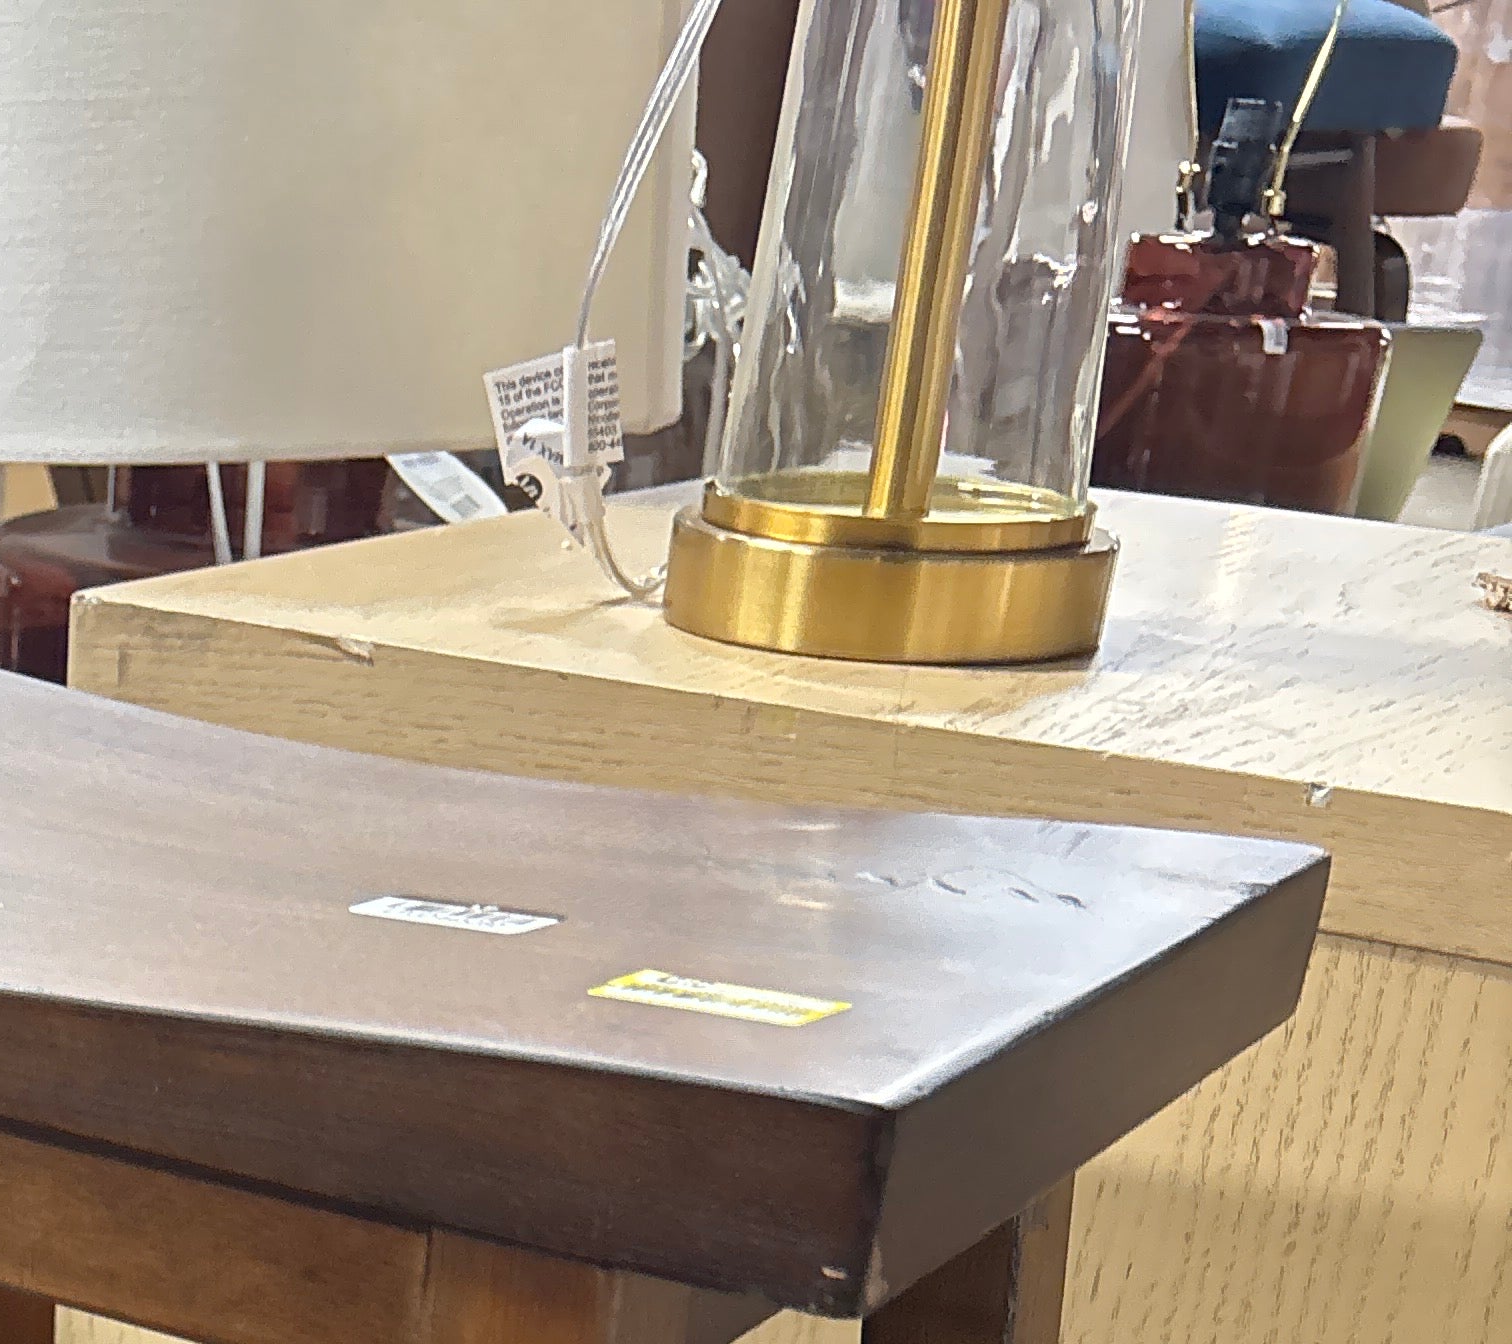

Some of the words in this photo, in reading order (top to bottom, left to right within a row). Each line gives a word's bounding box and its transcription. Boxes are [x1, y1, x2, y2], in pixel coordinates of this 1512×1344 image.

[495, 380, 517, 394] This
[519, 369, 552, 387] device
[501, 400, 550, 422] Operation
